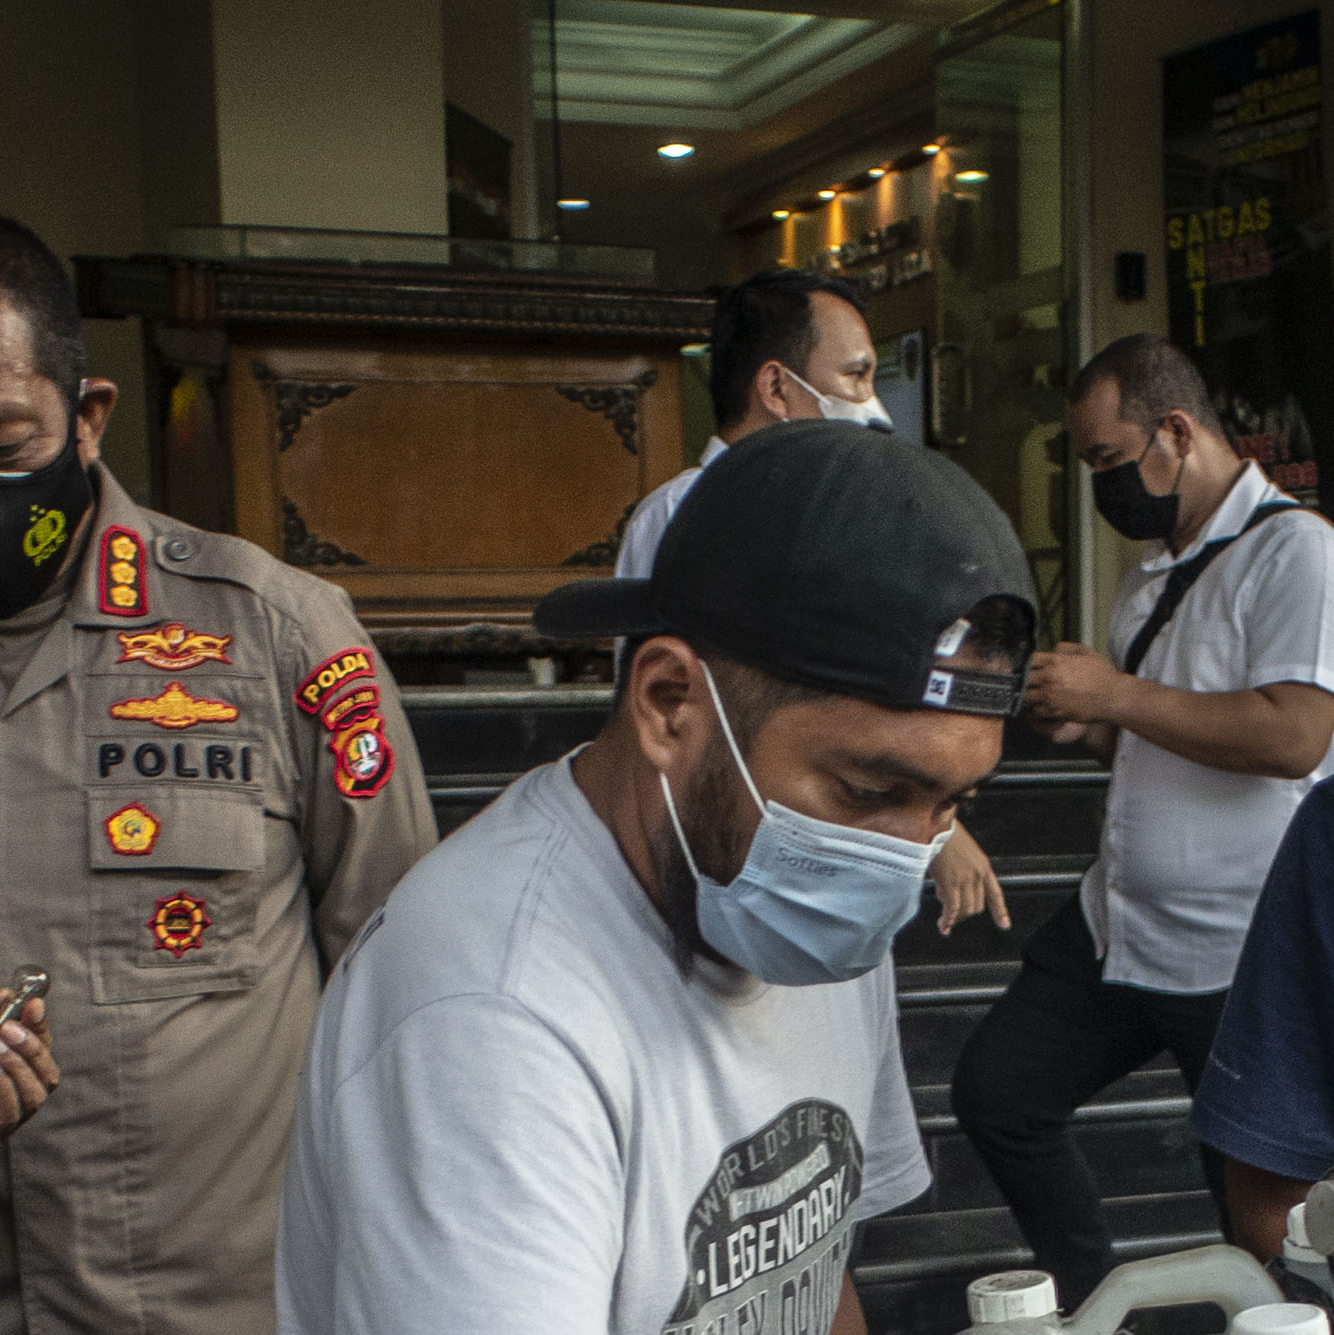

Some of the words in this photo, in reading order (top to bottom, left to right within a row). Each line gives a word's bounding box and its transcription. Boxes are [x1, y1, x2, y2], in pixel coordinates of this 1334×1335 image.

[1167, 196, 1272, 250] SATGAS
[301, 652, 371, 704] POLDA
[99, 743, 254, 783] POLRI
[777, 849, 840, 879] Softies
[707, 1165, 847, 1297] LEGENDARY
